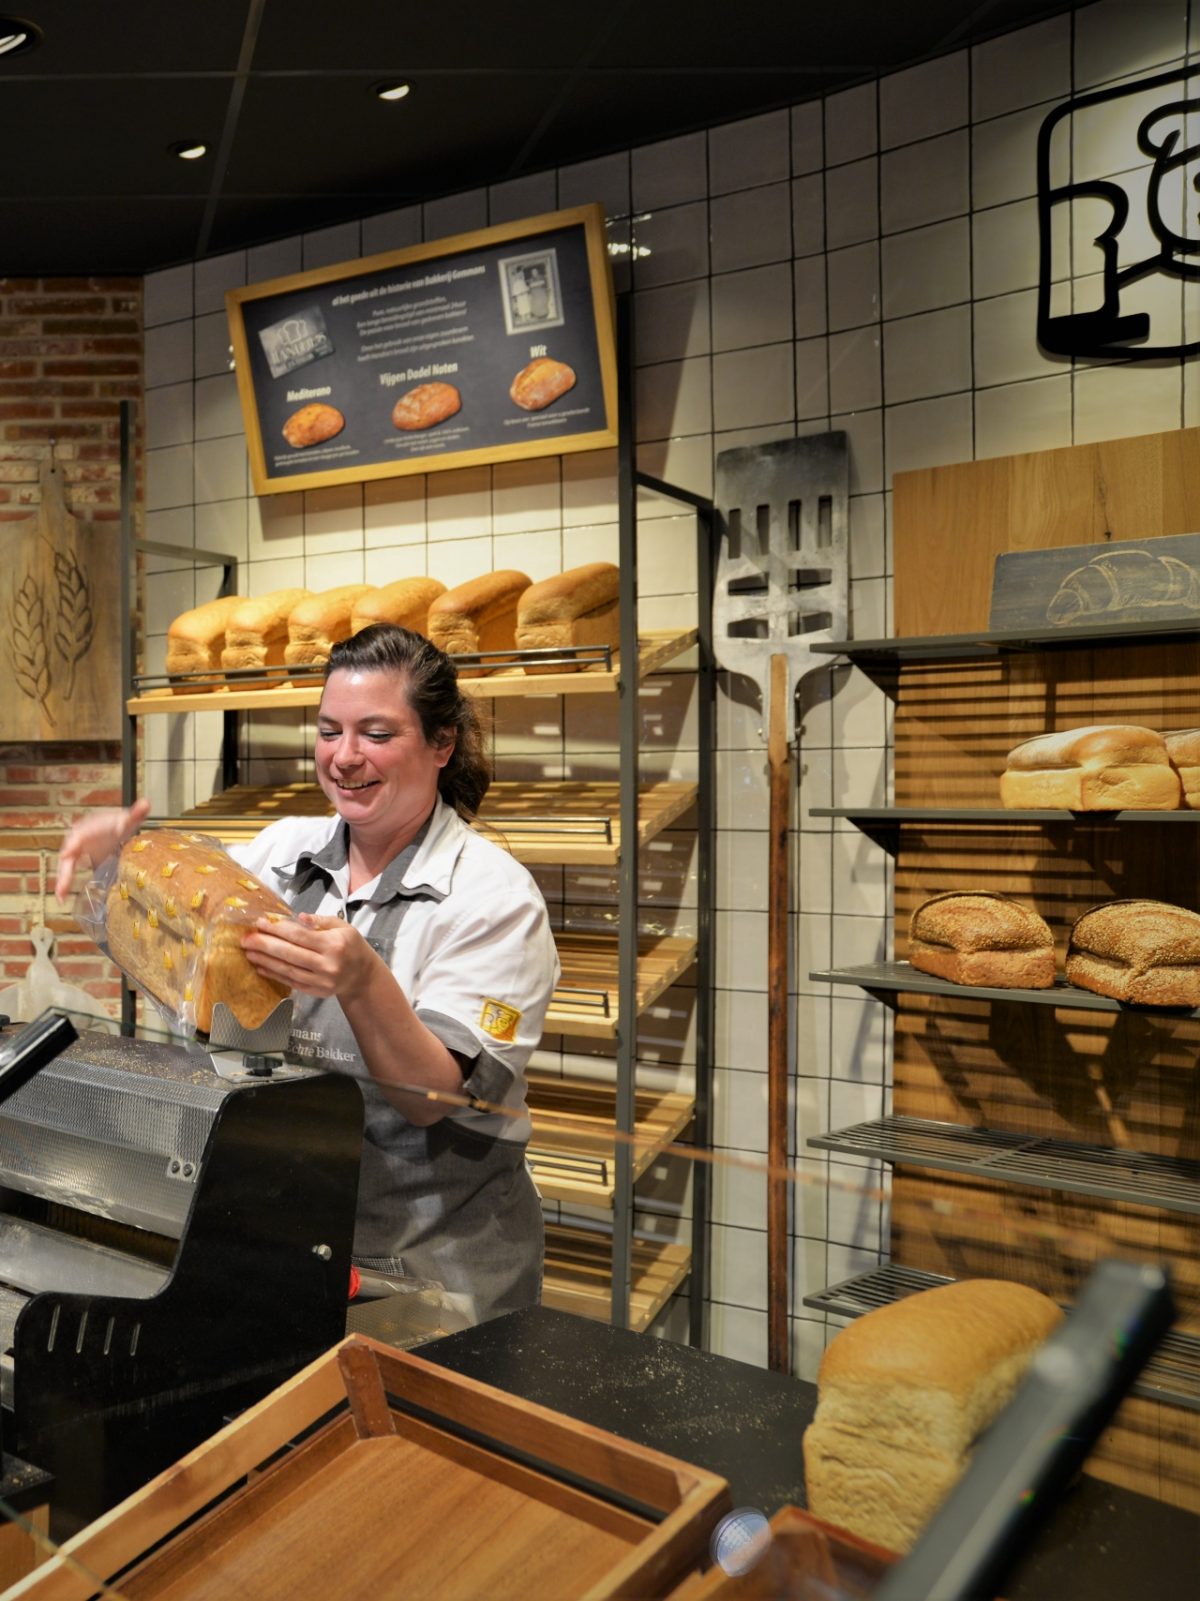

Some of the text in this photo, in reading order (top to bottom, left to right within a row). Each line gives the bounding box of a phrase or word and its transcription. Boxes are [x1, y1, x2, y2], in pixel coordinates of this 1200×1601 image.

[530, 344, 548, 358] Wit
[379, 372, 406, 387] Vijgen
[406, 365, 431, 380] Dadel
[290, 1028, 322, 1042] mans
[316, 1046, 356, 1062] Bakker
